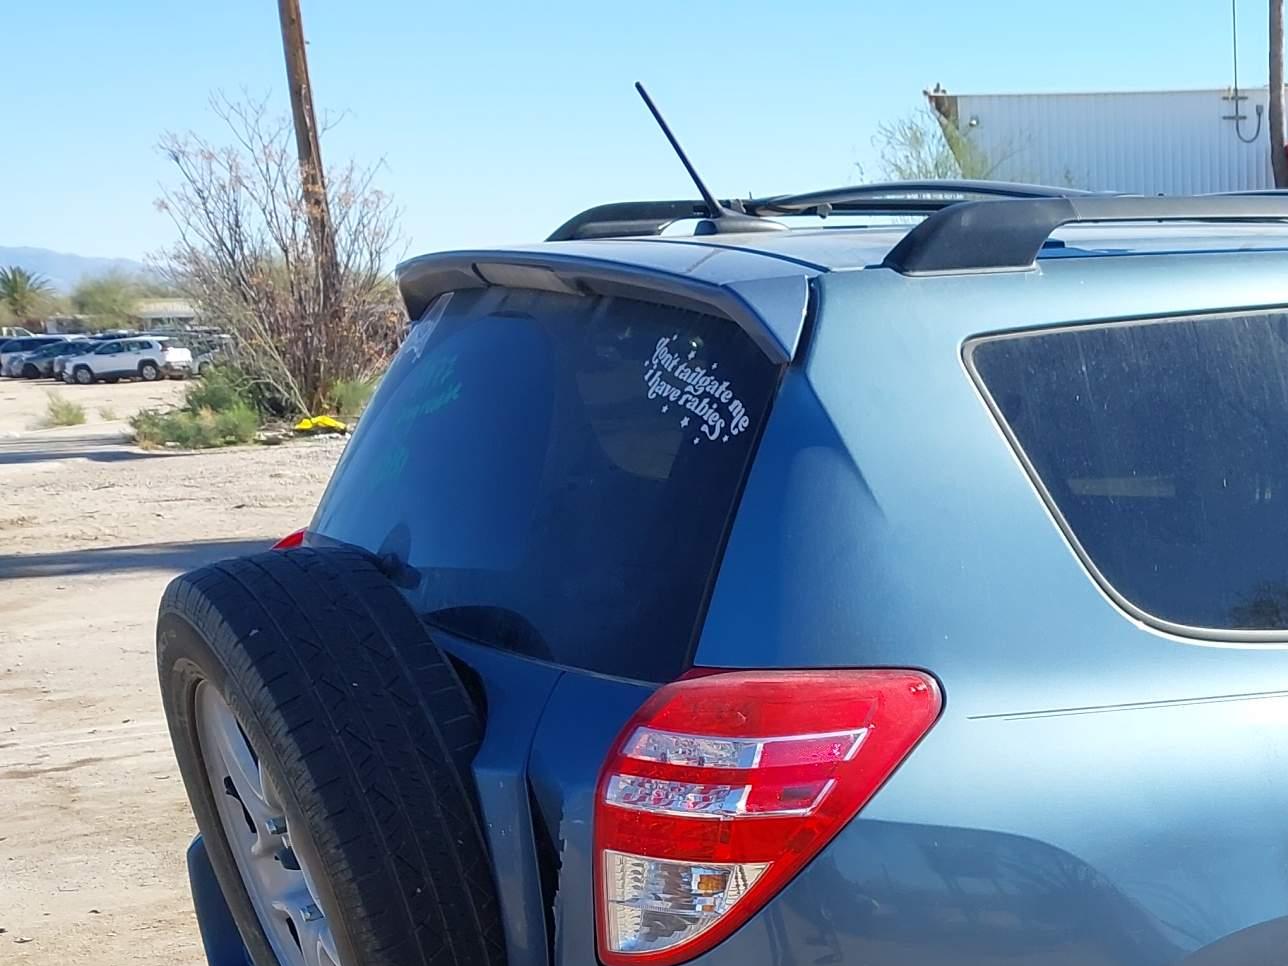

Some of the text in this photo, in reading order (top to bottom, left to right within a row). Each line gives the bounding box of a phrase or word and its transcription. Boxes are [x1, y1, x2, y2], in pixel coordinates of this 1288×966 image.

[647, 371, 681, 401] have
[678, 393, 726, 441] rabies
[674, 362, 733, 403] tailgate
[728, 399, 750, 435] me
